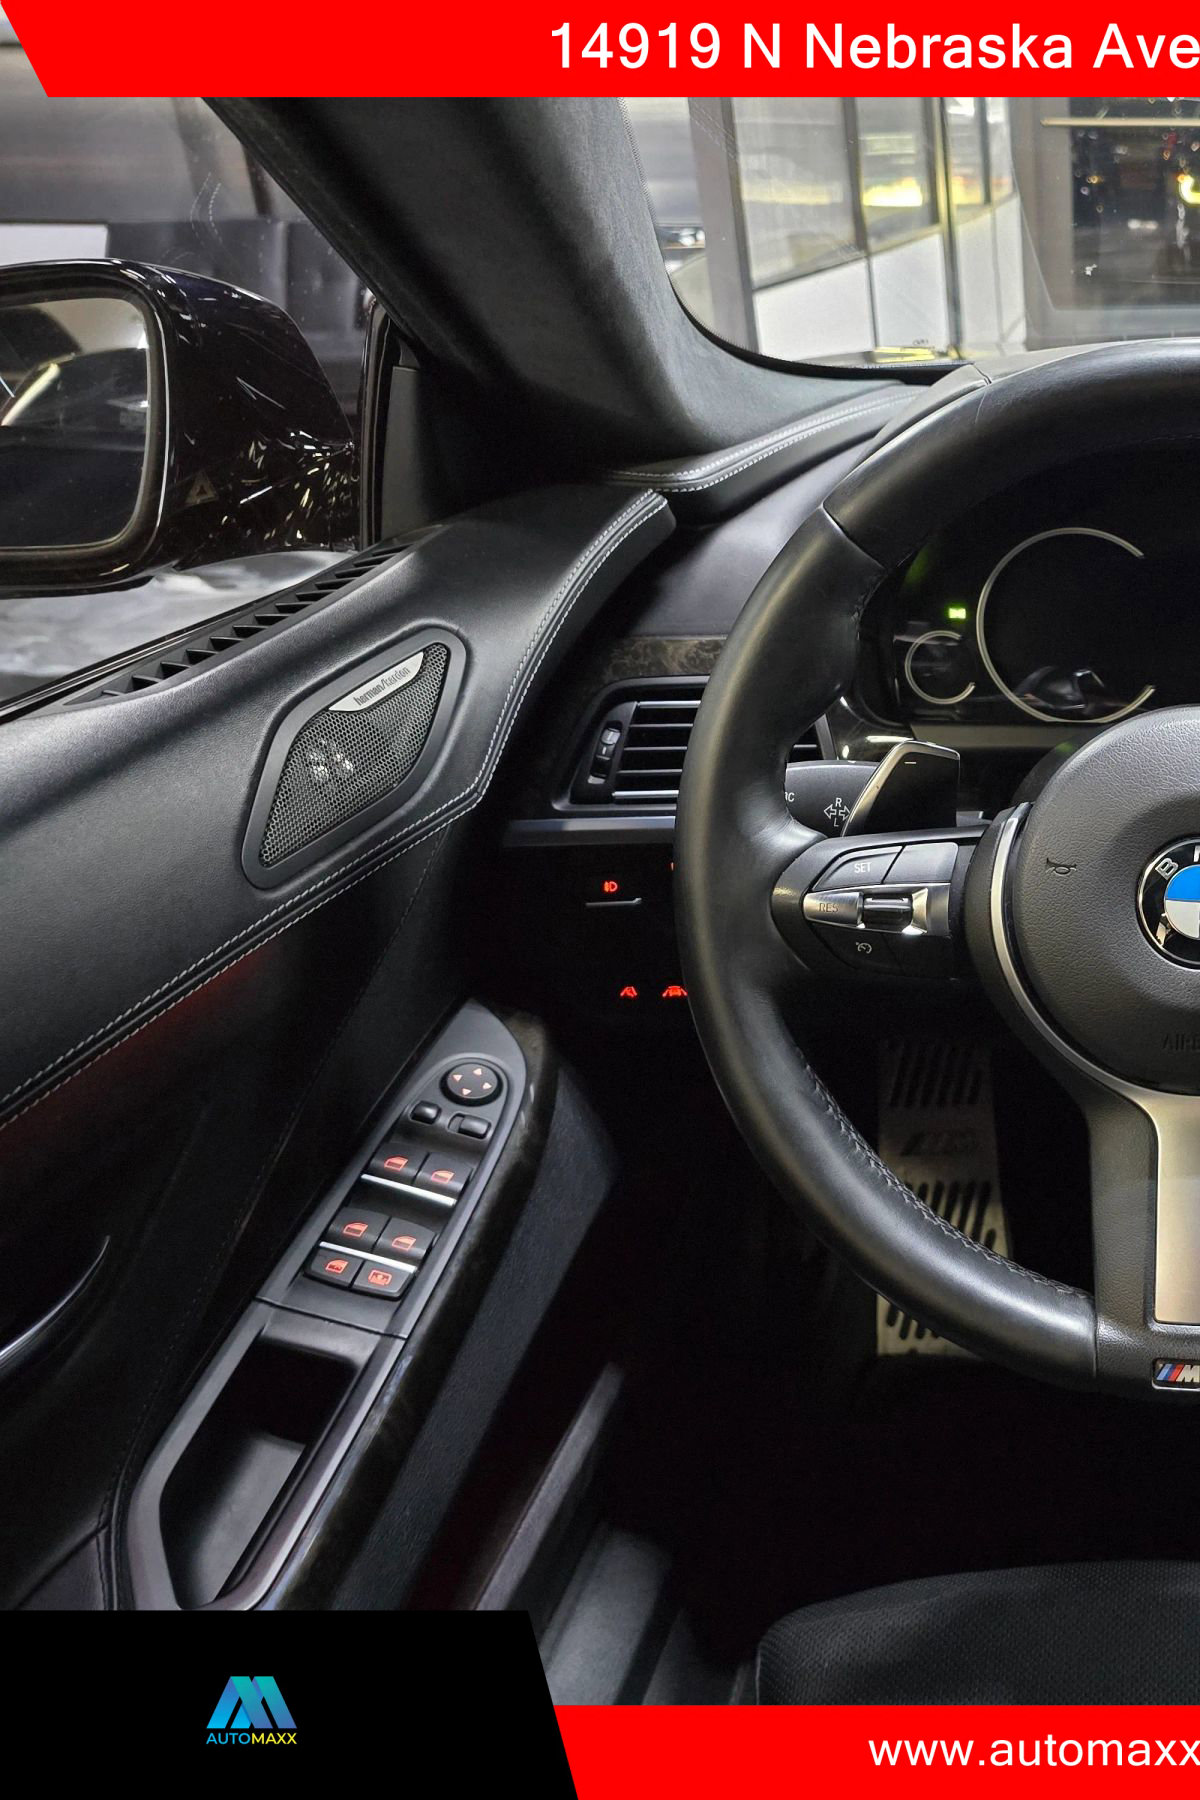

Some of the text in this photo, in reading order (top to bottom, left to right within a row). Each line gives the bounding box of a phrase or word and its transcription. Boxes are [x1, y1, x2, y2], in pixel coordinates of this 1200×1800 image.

[353, 666, 411, 706] harman/kardon
[835, 797, 842, 807] R
[854, 862, 872, 874] SET
[818, 902, 839, 913] RES
